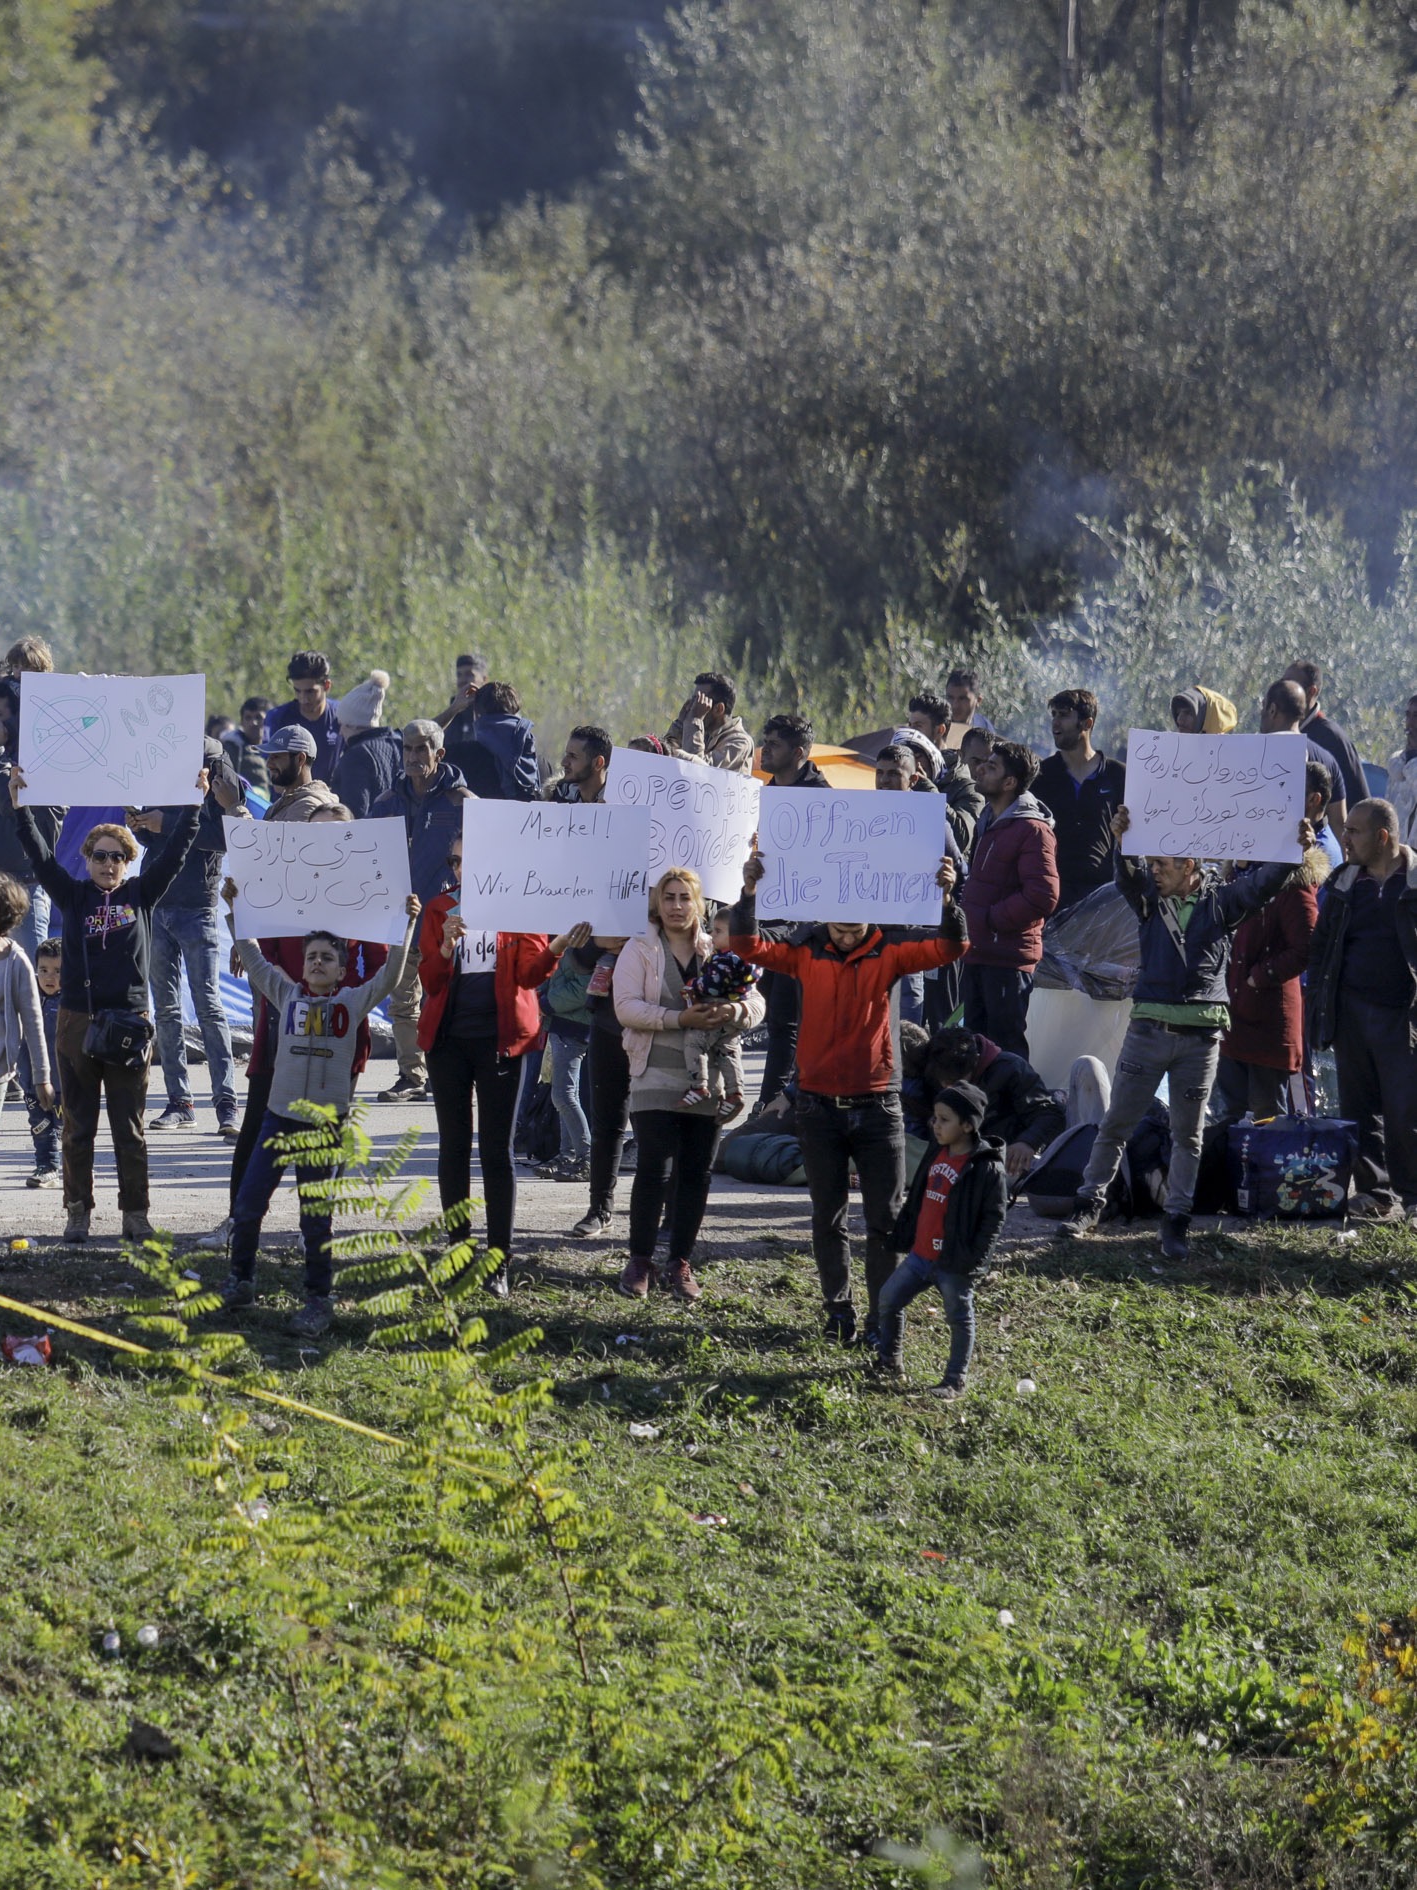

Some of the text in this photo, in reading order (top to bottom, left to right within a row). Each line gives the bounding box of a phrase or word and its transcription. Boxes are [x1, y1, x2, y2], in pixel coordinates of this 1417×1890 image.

[120, 683, 174, 737] NO
[107, 723, 188, 790] WAR
[473, 872, 514, 896] Wir
[523, 870, 594, 899] Brauchen
[761, 857, 822, 909] die
[285, 1001, 349, 1038] KENZO
